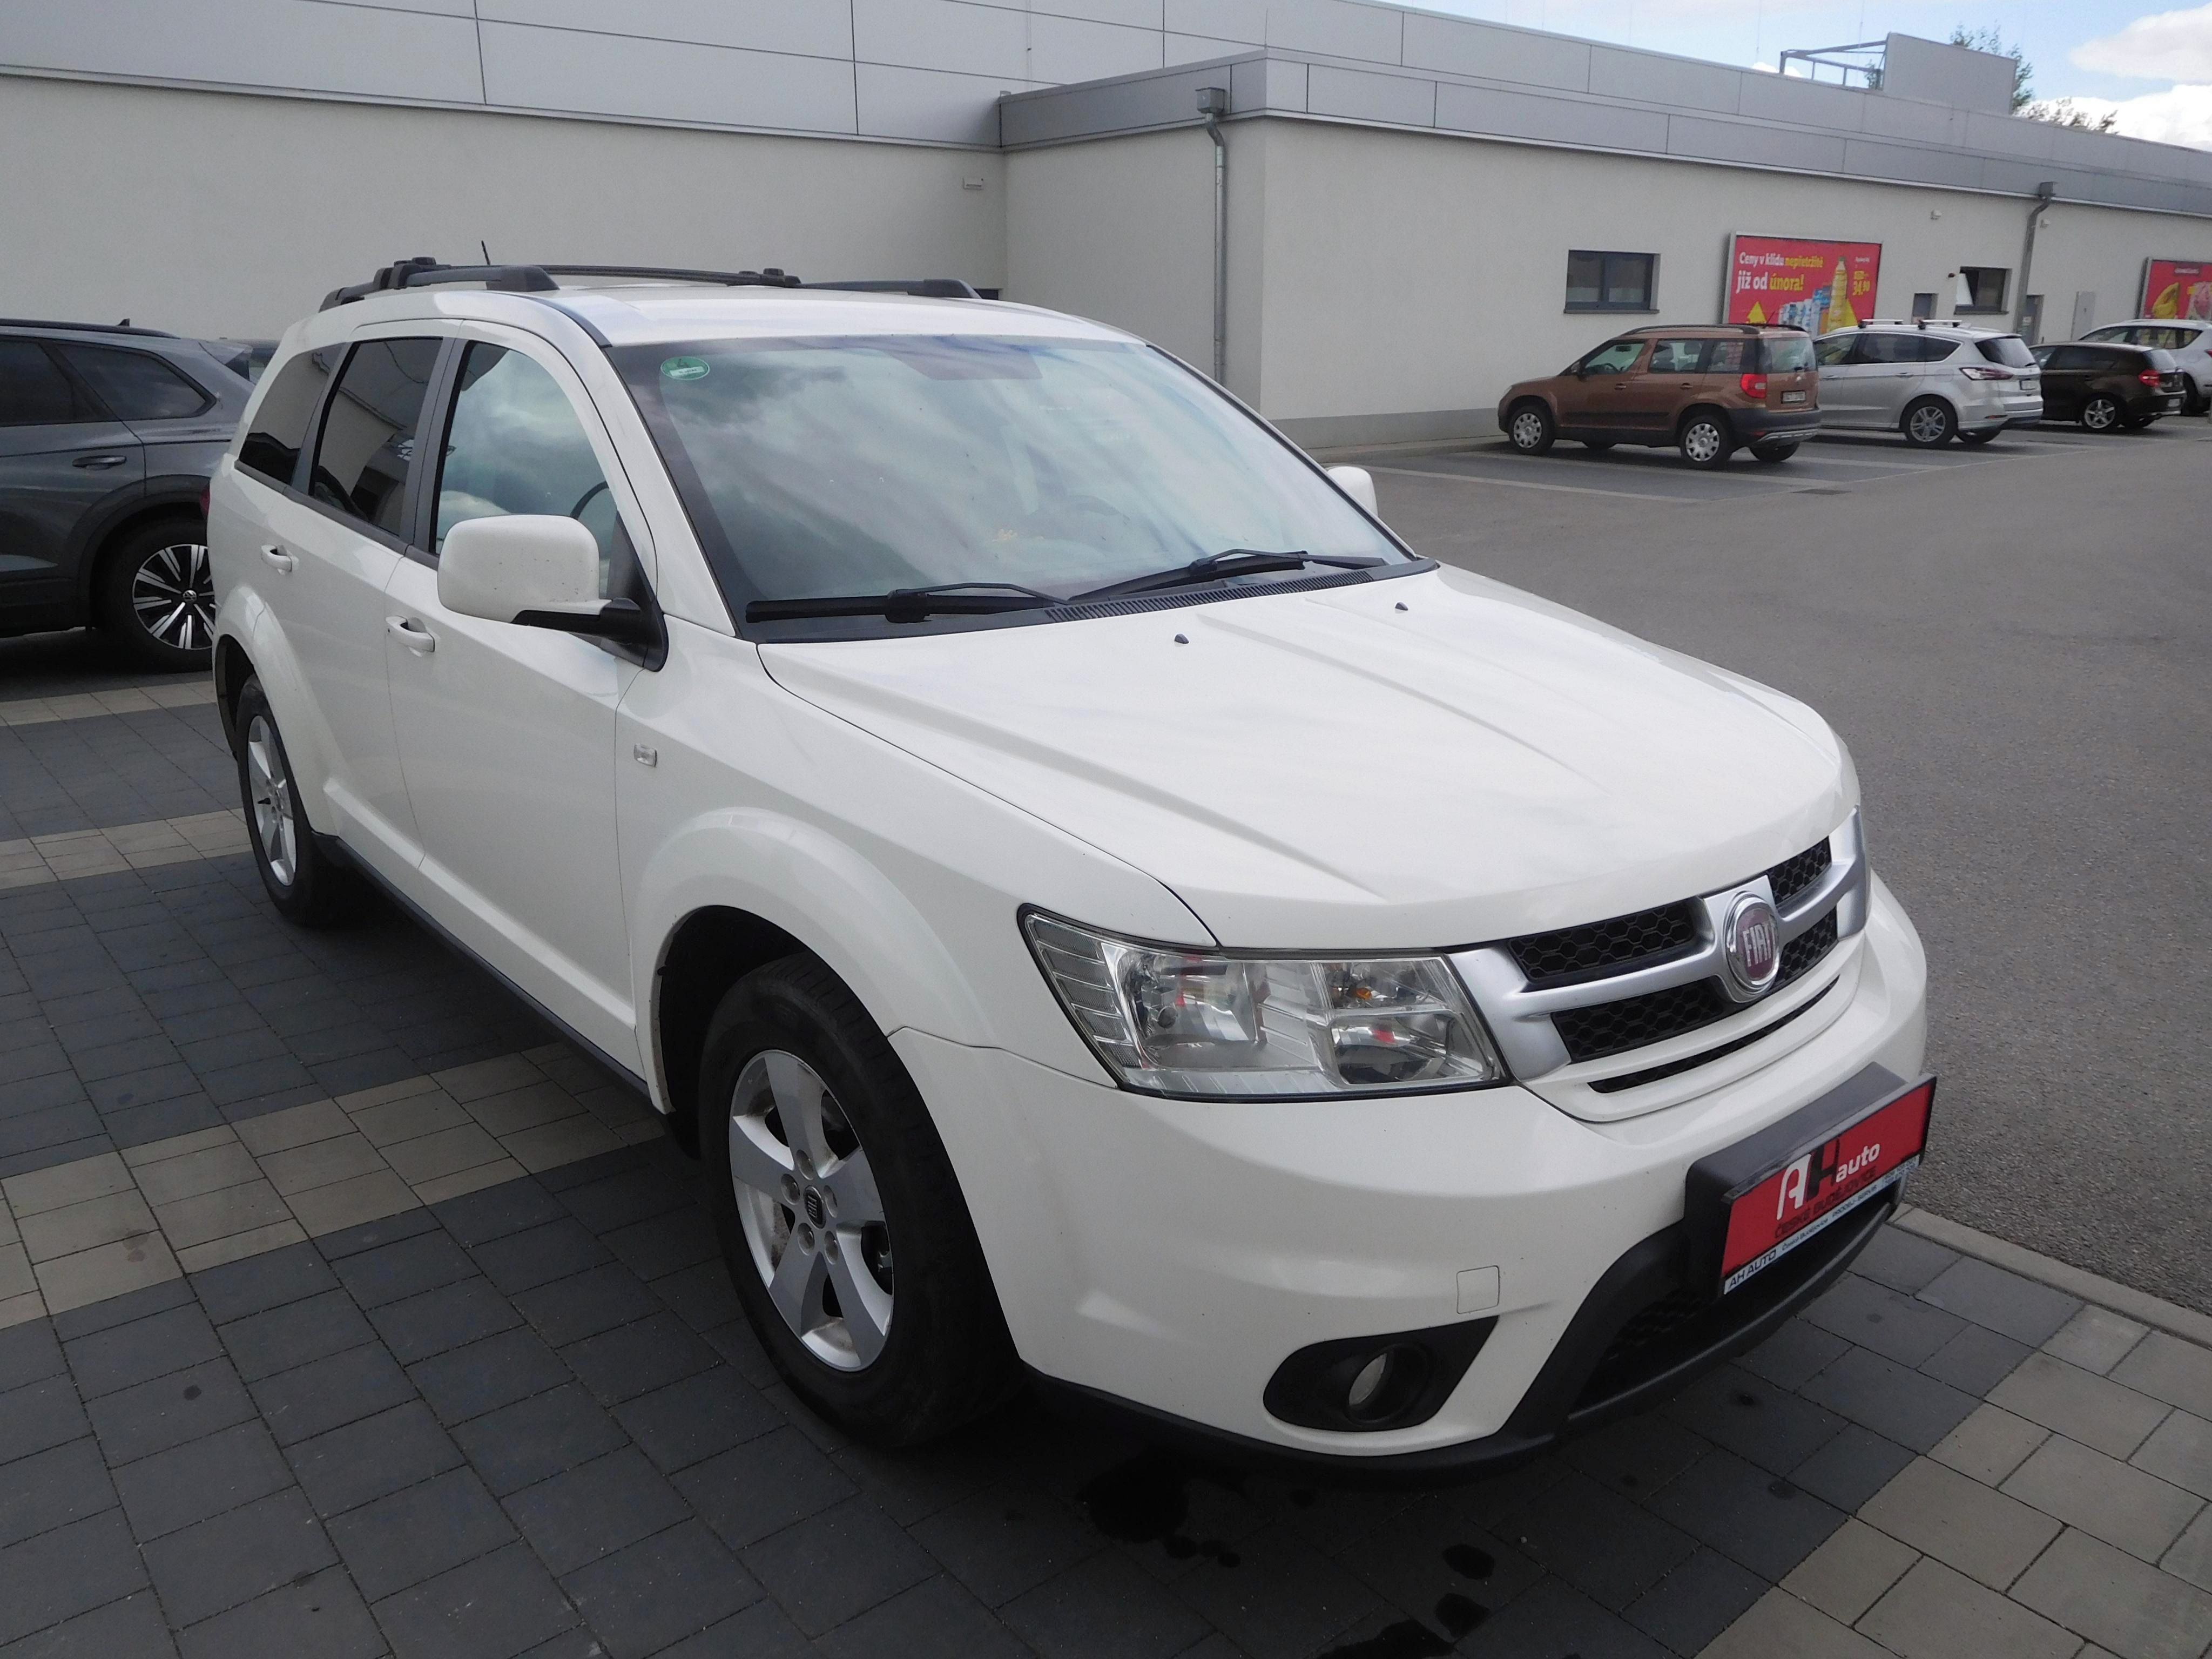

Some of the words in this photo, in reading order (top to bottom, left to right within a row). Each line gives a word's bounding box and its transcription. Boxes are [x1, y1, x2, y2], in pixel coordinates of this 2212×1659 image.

[1739, 252, 1759, 267] Ceny
[1759, 255, 1765, 265] v
[1765, 253, 1784, 266] klidu
[1736, 270, 1751, 294] již
[1753, 272, 1768, 290] od
[1770, 273, 1804, 291] února!
[1742, 921, 1776, 968] FIAT
[1729, 1270, 1745, 1289] AH
[1746, 1249, 1777, 1277] AUTO
